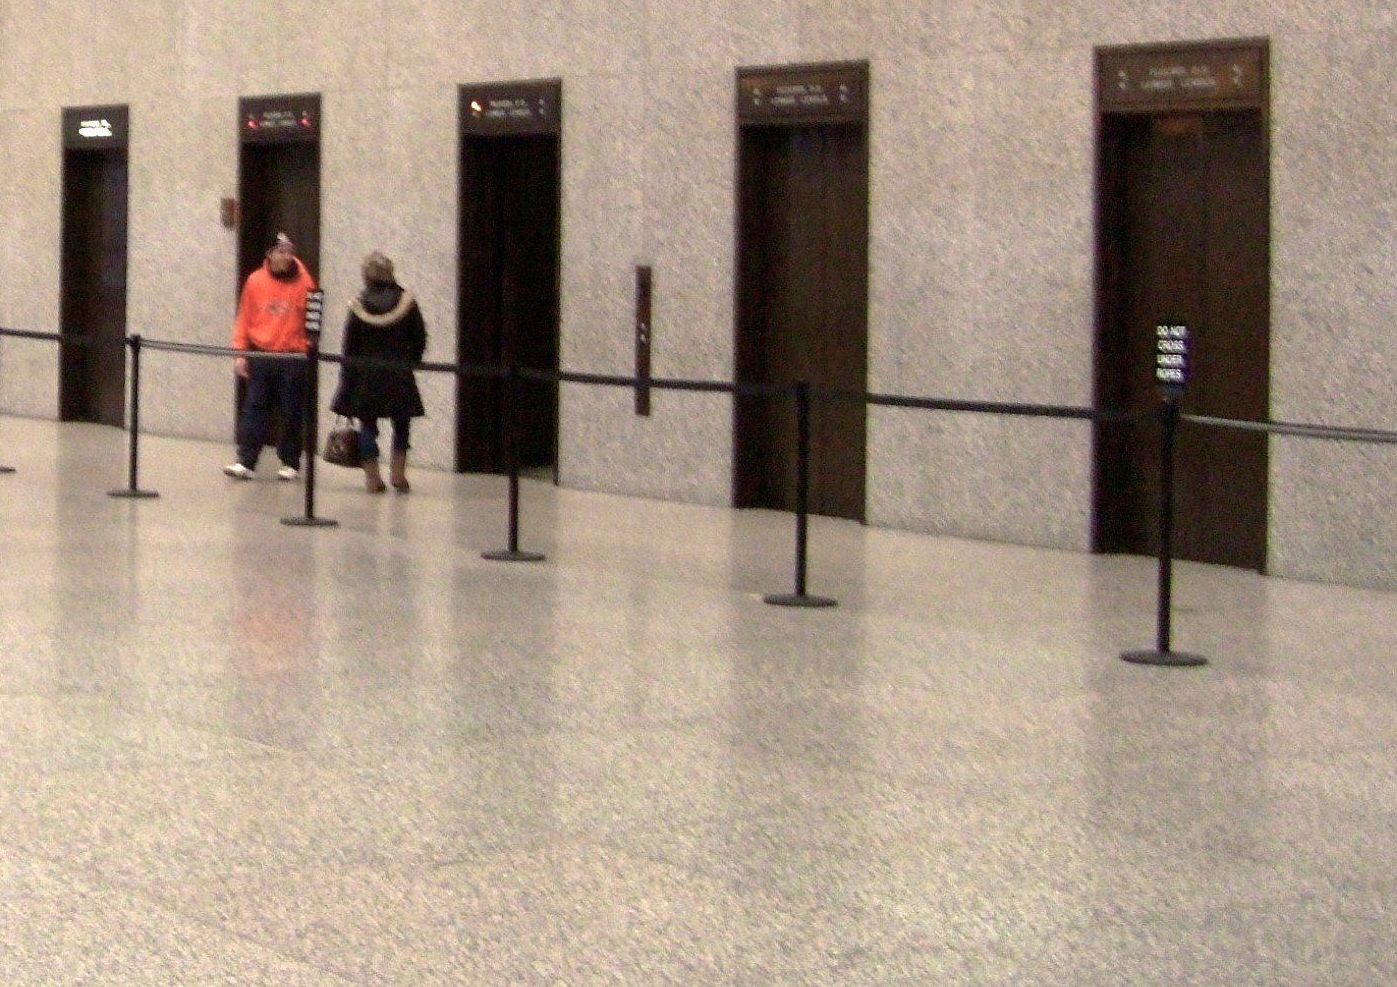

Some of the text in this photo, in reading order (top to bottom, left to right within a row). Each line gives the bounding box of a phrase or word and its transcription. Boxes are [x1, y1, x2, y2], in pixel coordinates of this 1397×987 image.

[1156, 325, 1187, 338] DO NOT
[1157, 339, 1185, 353] CROSS
